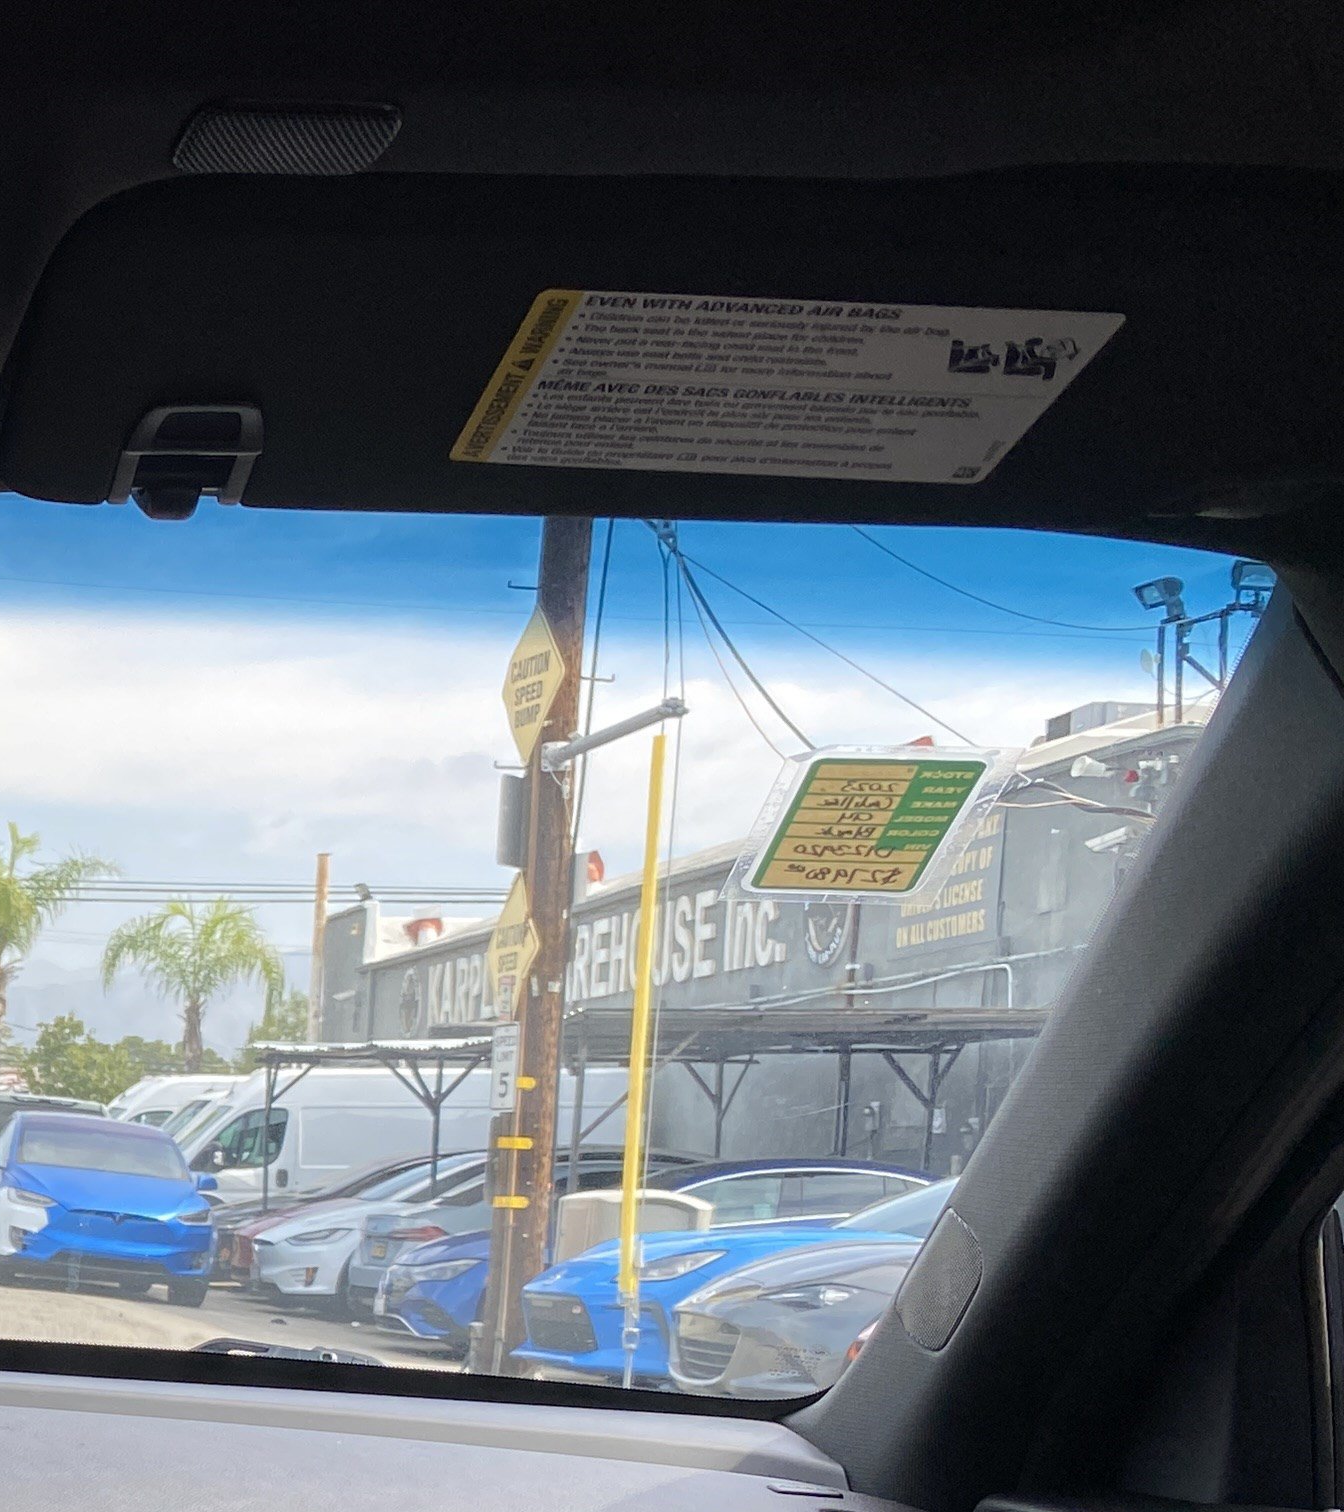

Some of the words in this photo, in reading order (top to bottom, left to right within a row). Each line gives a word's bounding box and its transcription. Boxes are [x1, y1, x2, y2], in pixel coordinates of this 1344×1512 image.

[585, 296, 638, 309] EVEN
[641, 298, 693, 311] WITH
[696, 300, 804, 315] ADVANCED
[807, 305, 844, 317] AIR
[847, 307, 903, 320] BAGS
[538, 378, 592, 392] MÊME
[594, 382, 640, 395] AVEC
[643, 384, 679, 396] DES
[682, 386, 730, 398] SACS
[733, 388, 845, 403] GONFLABLES
[849, 392, 972, 408] INTELLIGENTS
[510, 649, 551, 685] CAUTION
[514, 680, 543, 707] SPEED
[514, 703, 541, 729] BUMP
[979, 845, 994, 871] OF
[943, 878, 984, 909] LICENSE
[723, 896, 788, 972] Inc.
[896, 926, 909, 949] ON
[910, 922, 925, 946] ALL
[926, 908, 986, 942] CUSTOMERS
[496, 1049, 514, 1064] LIMIT
[498, 1072, 510, 1098] 5
